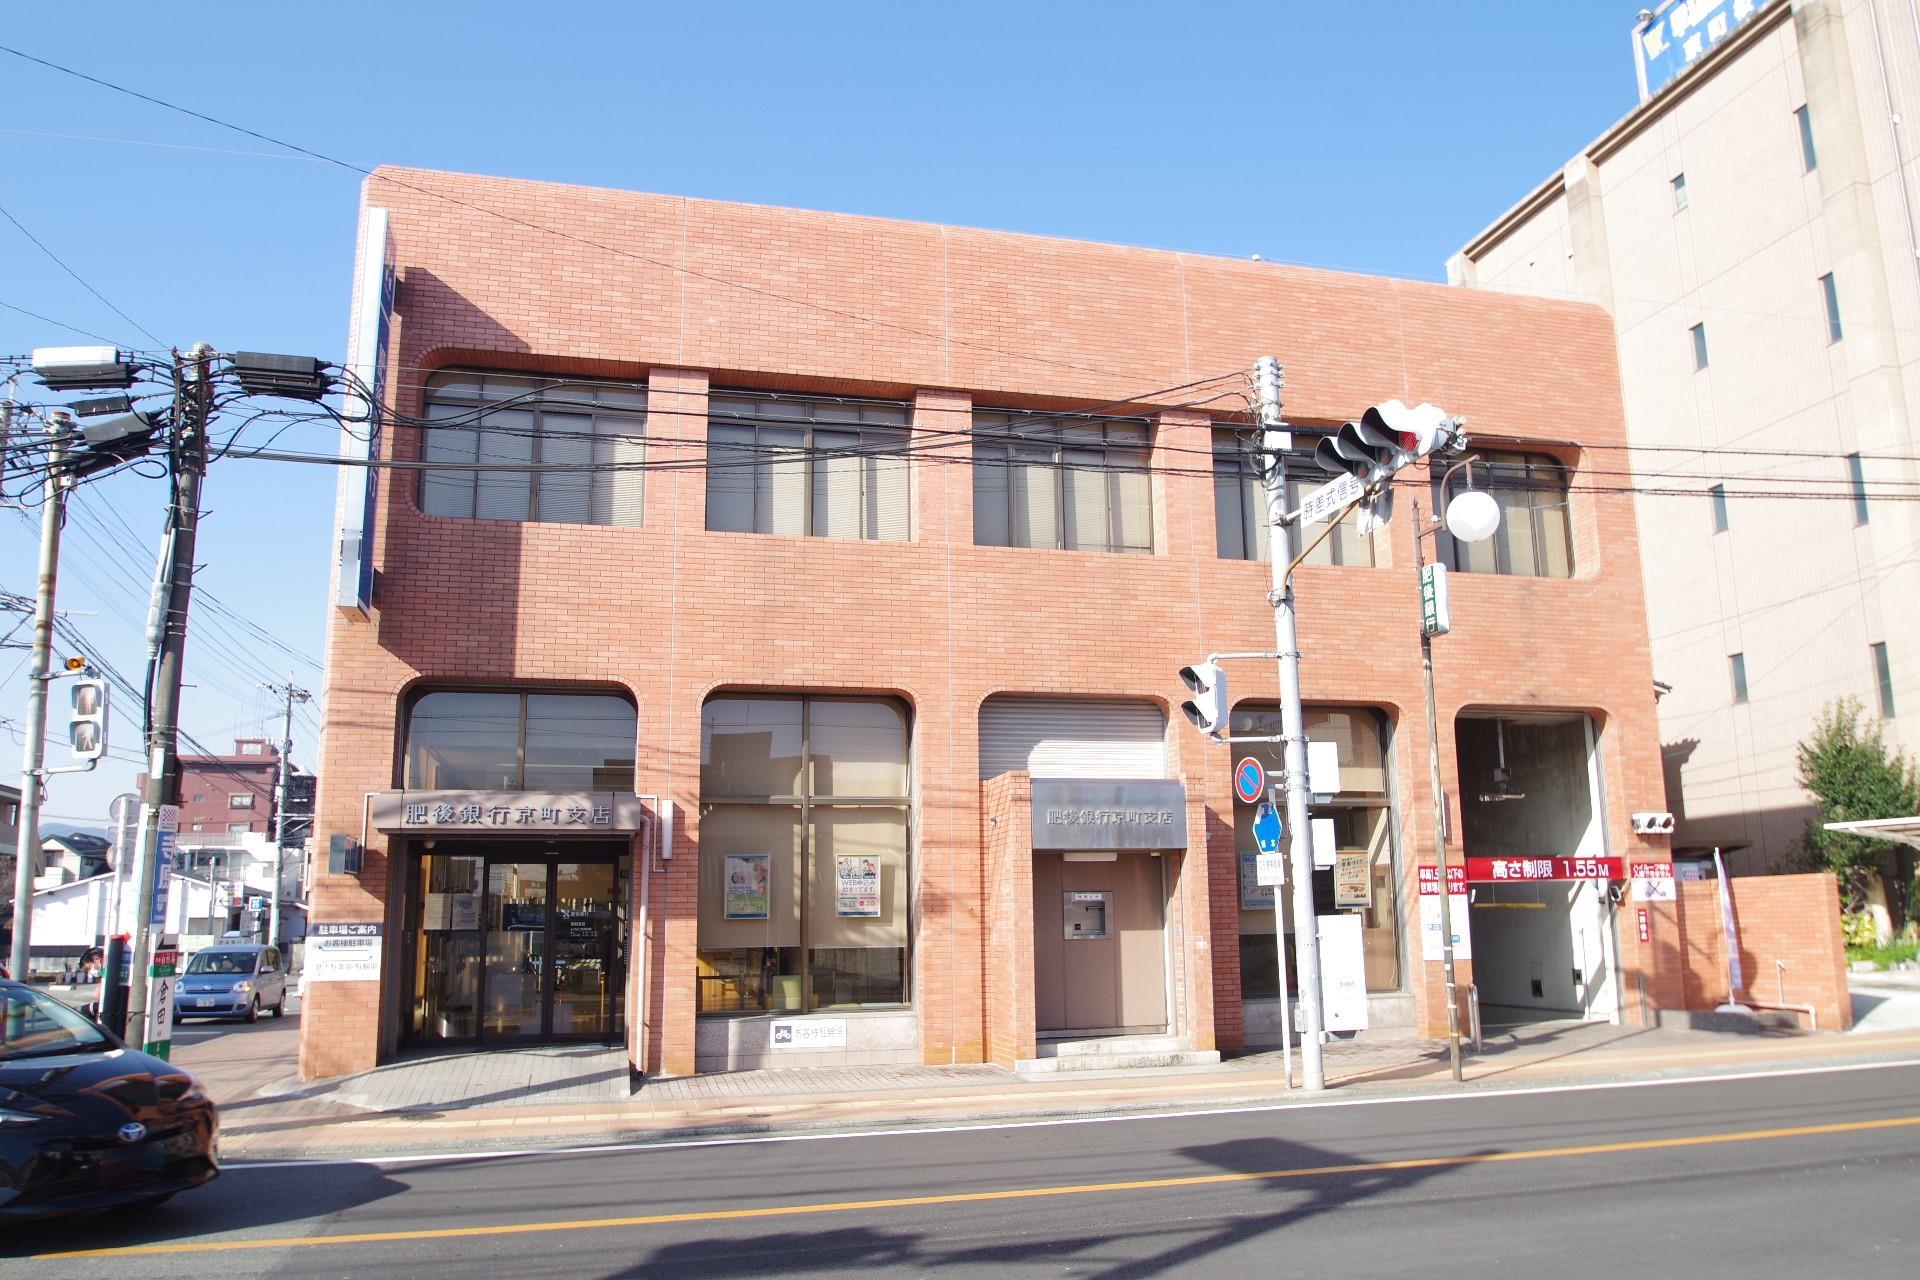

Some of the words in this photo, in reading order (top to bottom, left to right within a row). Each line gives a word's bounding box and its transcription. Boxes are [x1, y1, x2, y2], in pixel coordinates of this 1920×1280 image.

[1304, 476, 1359, 520] 時差式信号
[1422, 566, 1436, 634] 肥後銀行
[405, 803, 611, 825] 肥後銀行京町支店
[1047, 810, 1174, 825] 肥後銀行京町支店
[1491, 859, 1553, 879] 高さ制限
[318, 924, 377, 935] 駐車場ご案内
